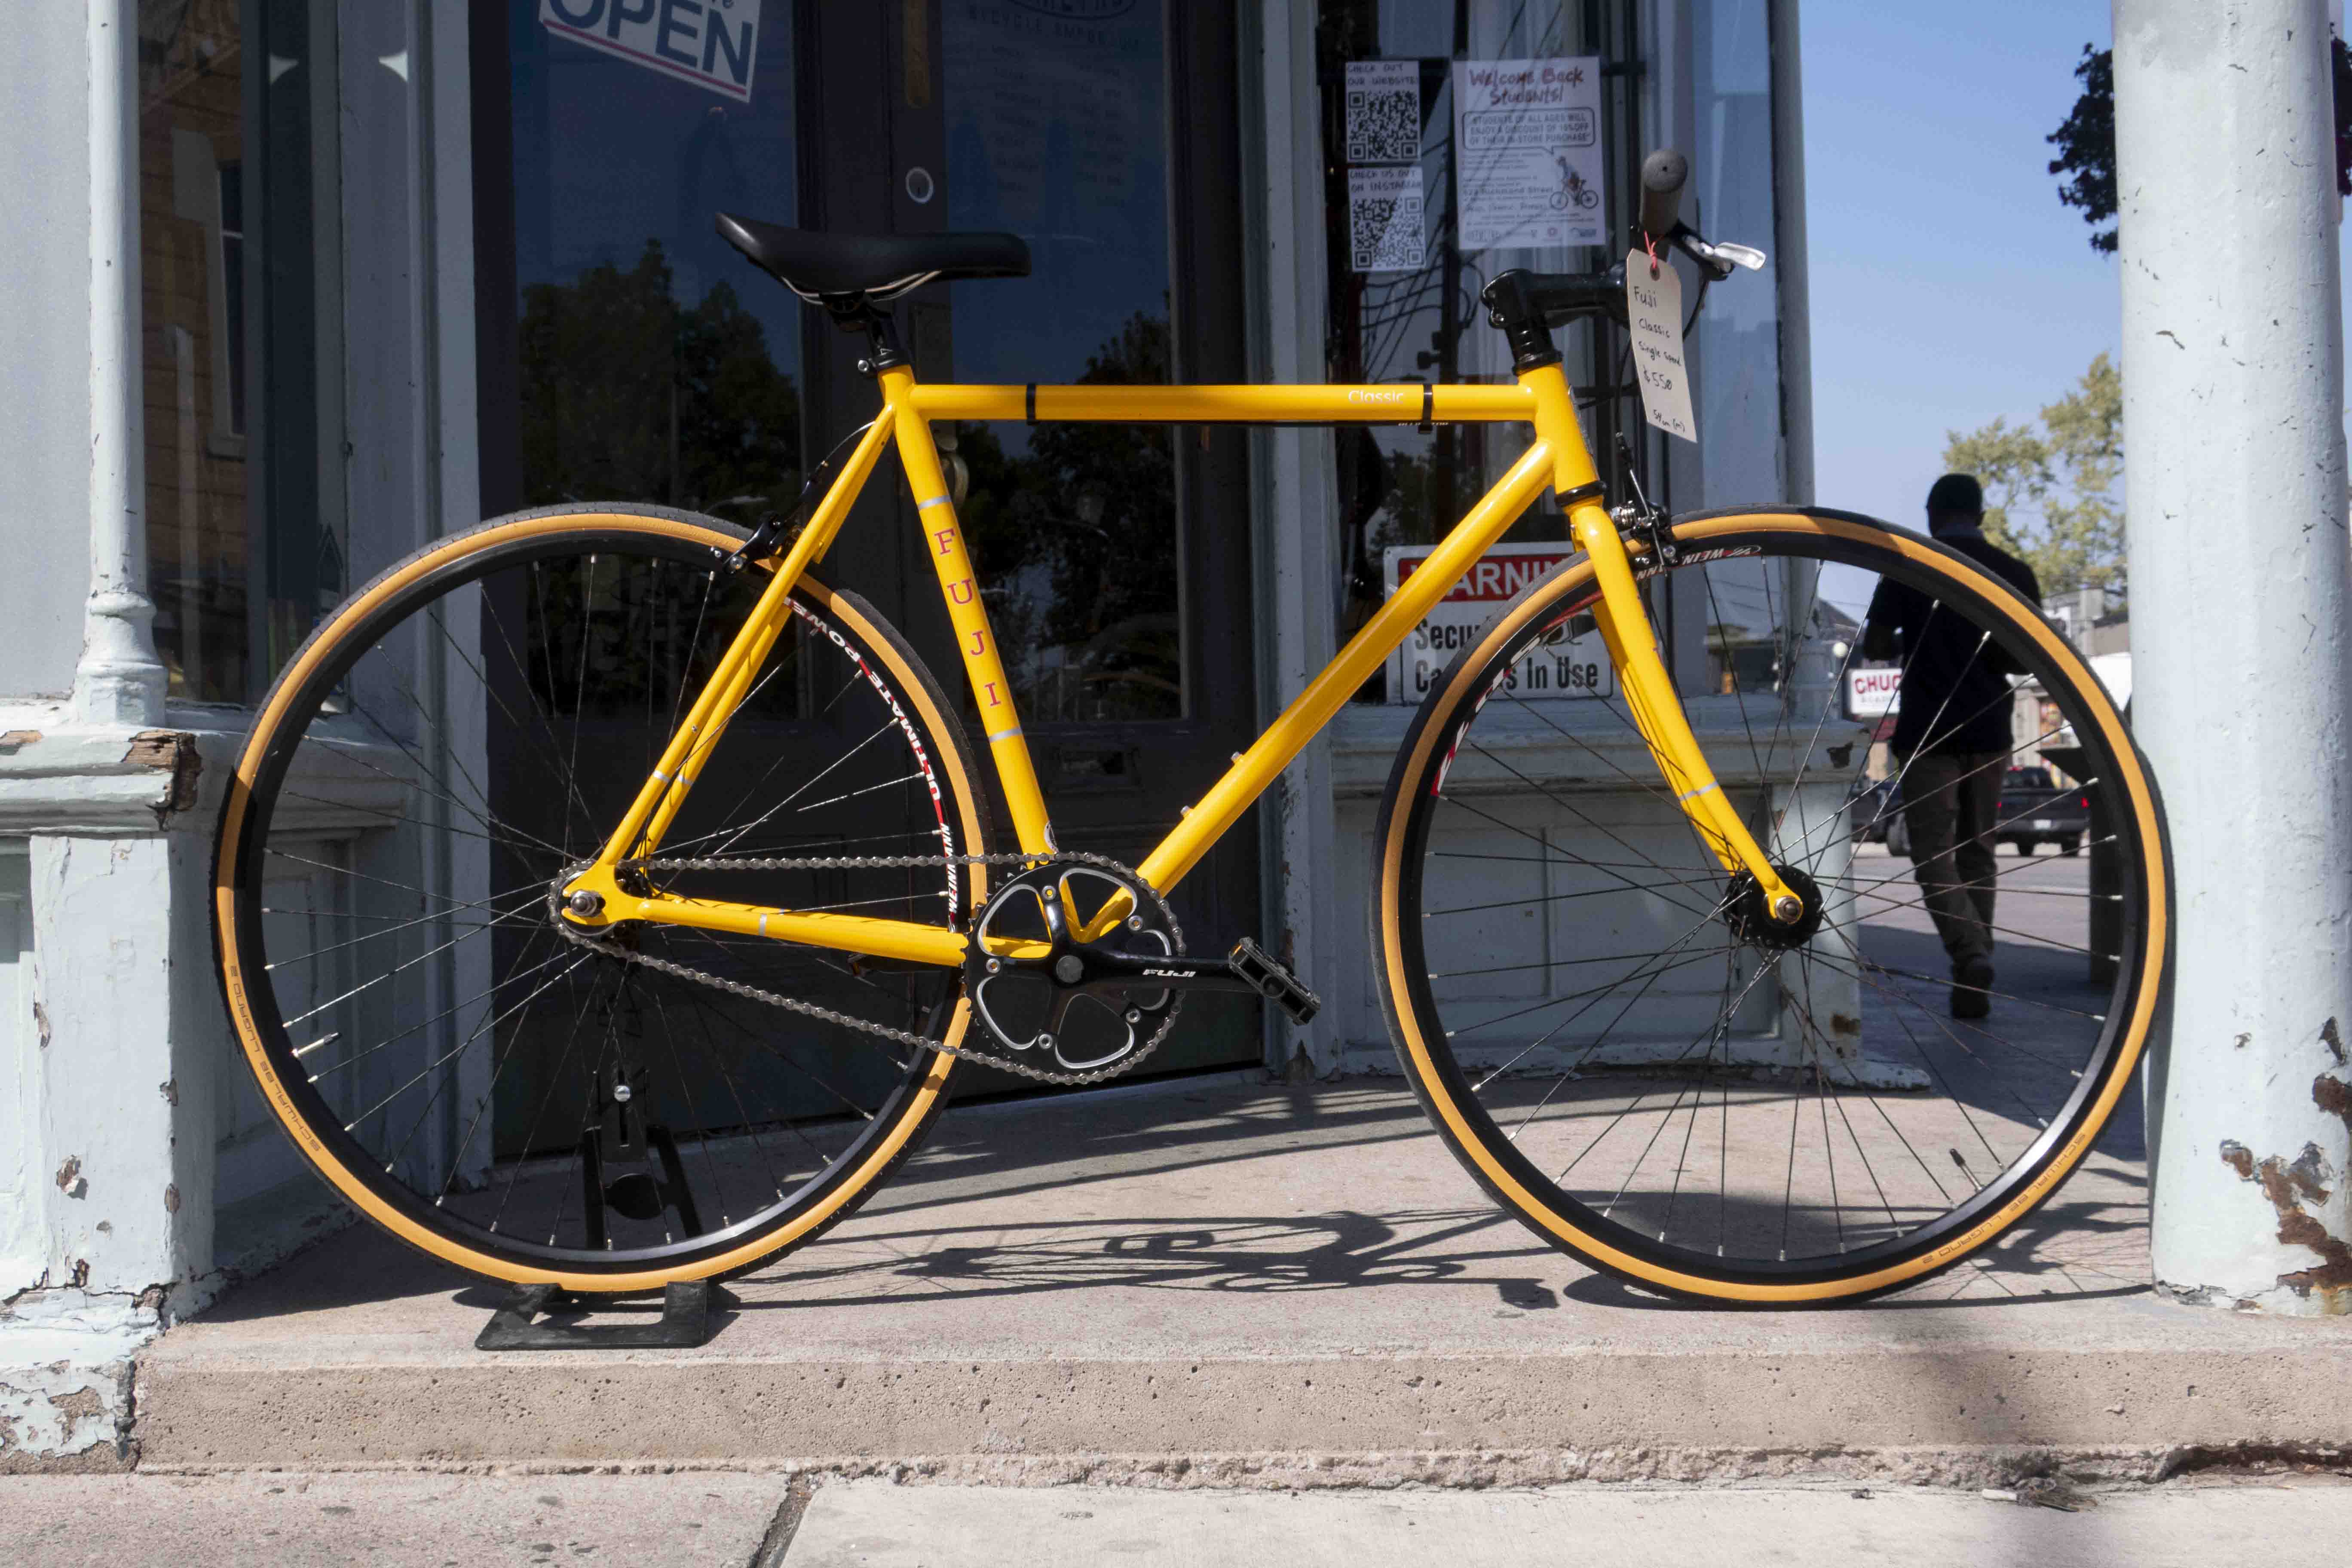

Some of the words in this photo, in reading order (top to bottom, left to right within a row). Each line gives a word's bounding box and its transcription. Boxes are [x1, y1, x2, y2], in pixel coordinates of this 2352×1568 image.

[1469, 67, 1534, 86] Welcome
[1541, 66, 1583, 87] Back
[1528, 114, 1541, 122] ALL
[1568, 113, 1586, 121] WILL
[1634, 285, 1657, 308] Fuji
[1639, 318, 1670, 338] Classic
[1643, 364, 1672, 390] $550
[1348, 390, 1404, 404] Classic
[934, 528, 1001, 707] FUJI
[1556, 656, 1598, 688] Use
[867, 671, 941, 801] ULTIMATE
[1142, 969, 1196, 977] FUJI
[233, 983, 262, 1053] LUGANO
[260, 1060, 322, 1152] SCHWALBE
[2008, 1133, 2087, 1213] SCHWALBE
[1939, 1215, 2003, 1258] LUGANO
